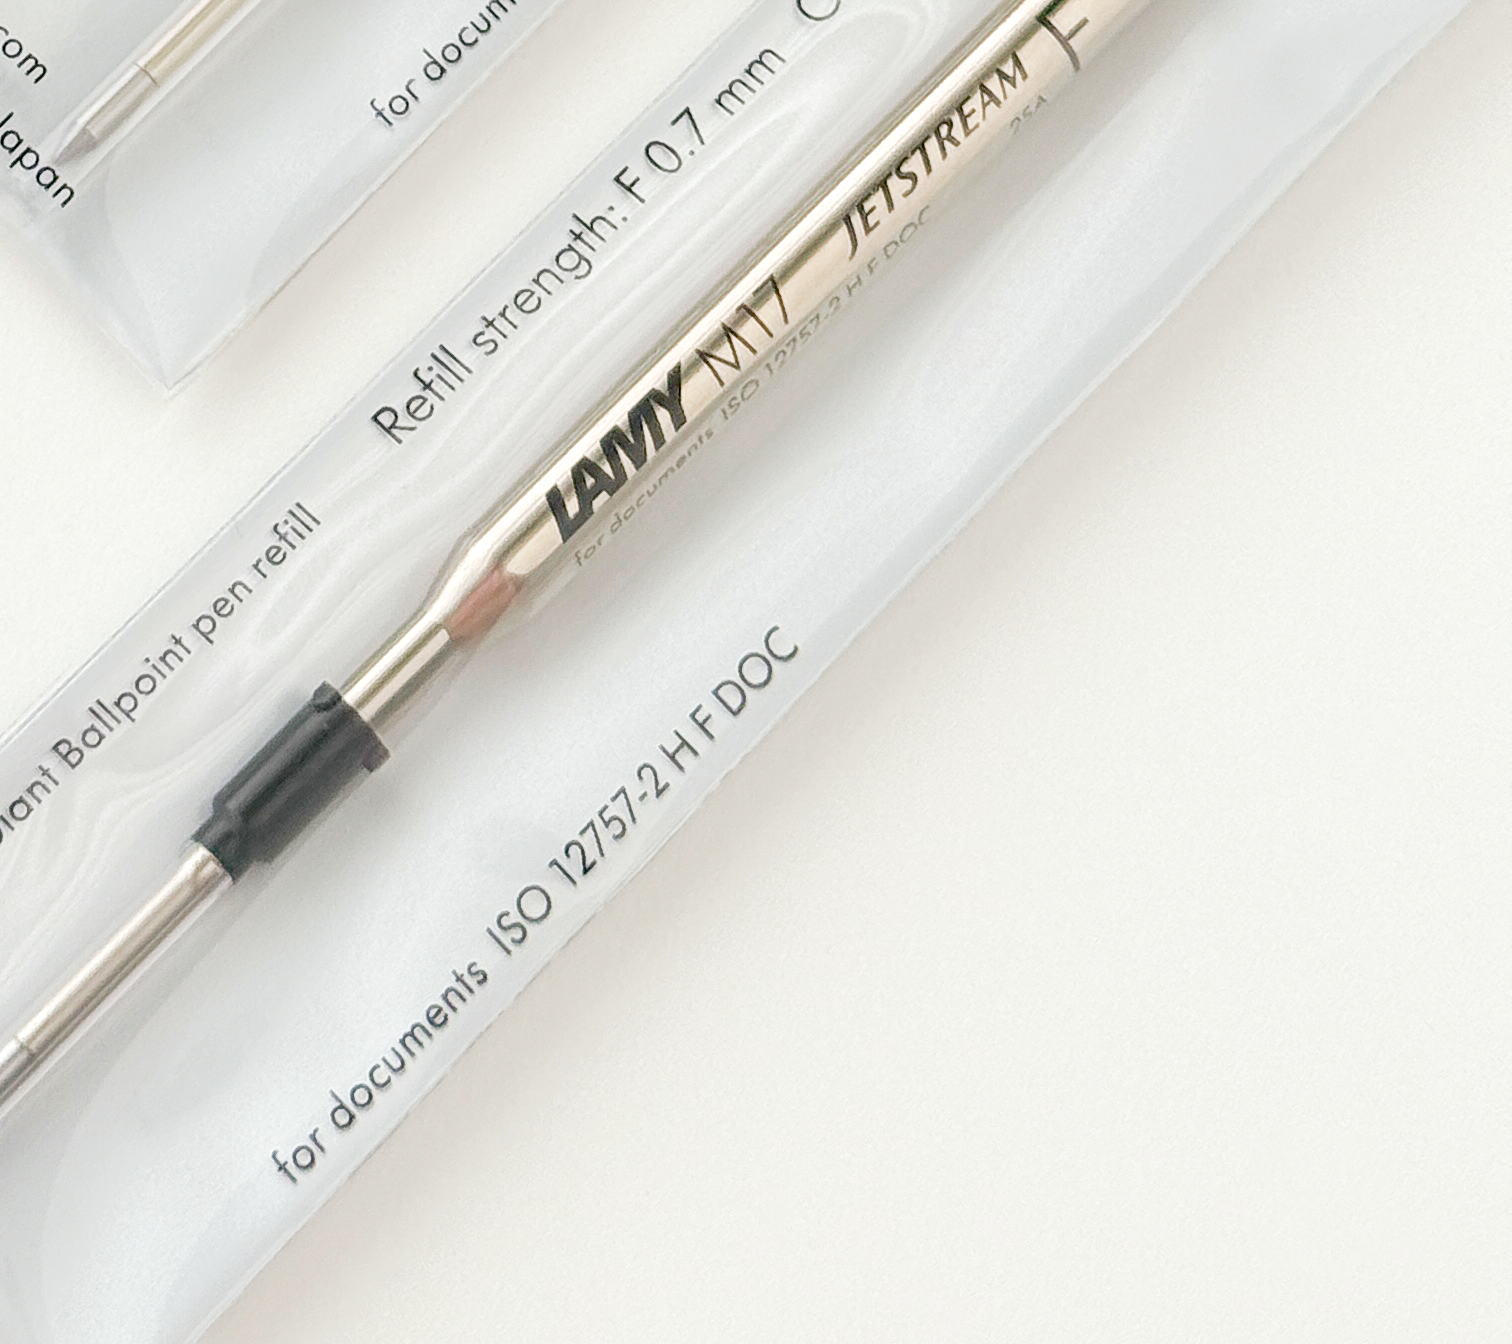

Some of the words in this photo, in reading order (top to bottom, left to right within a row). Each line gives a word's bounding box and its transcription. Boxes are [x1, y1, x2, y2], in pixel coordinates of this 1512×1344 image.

[369, 77, 420, 127] for
[370, 343, 474, 446] Refill
[472, 204, 629, 357] strength:
[612, 165, 646, 205] F
[644, 105, 706, 174] 0.7
[714, 46, 787, 116] mm
[545, 362, 688, 545] LAMY
[694, 273, 789, 387] M17
[841, 50, 1029, 261] JETSTREAM
[574, 535, 604, 568] for
[609, 426, 716, 537] documents
[719, 378, 761, 421] ISO
[765, 295, 841, 378] 12757-2
[845, 275, 863, 296] H
[883, 204, 931, 260] DOC
[52, 633, 192, 771] Ballpoint
[190, 579, 254, 646] pen
[252, 502, 322, 580] refill
[271, 1126, 327, 1185] for
[329, 961, 488, 1131] documents
[485, 884, 553, 957] ISO
[548, 762, 671, 888] 12757-2
[658, 729, 701, 774] H
[688, 703, 716, 742] F
[711, 625, 799, 718] DOC
